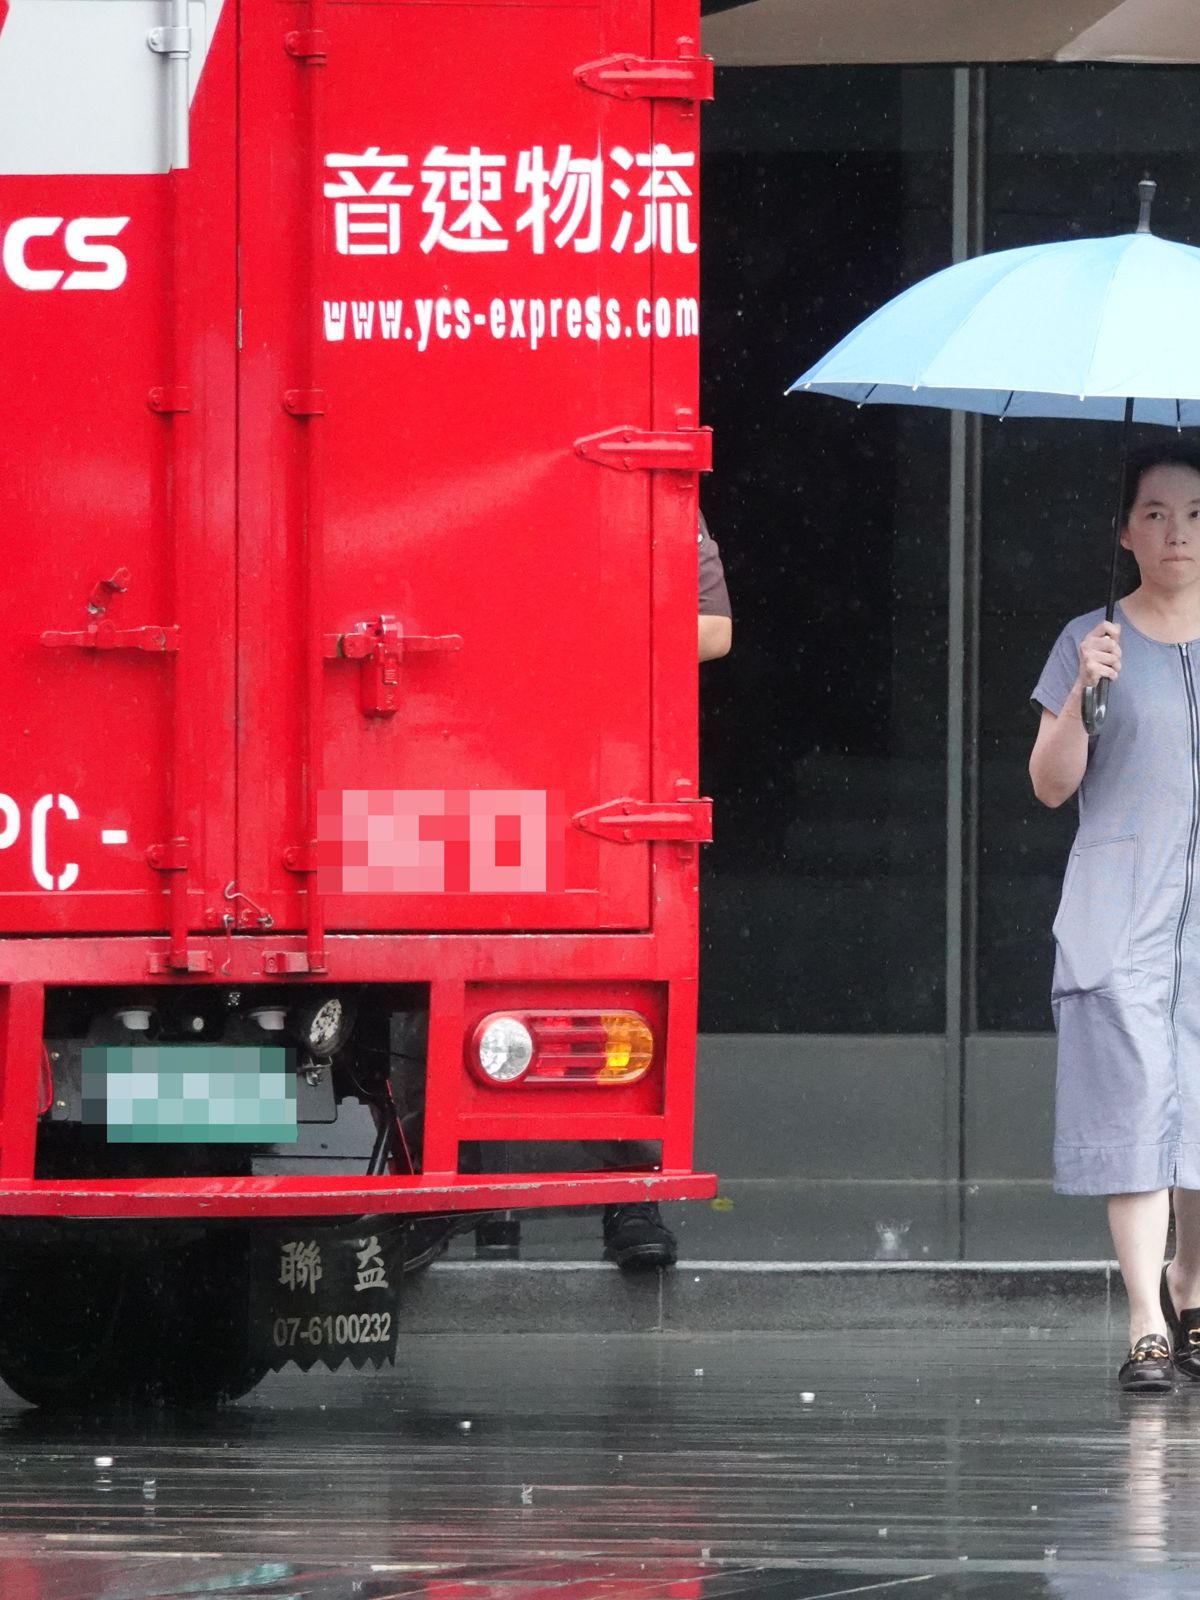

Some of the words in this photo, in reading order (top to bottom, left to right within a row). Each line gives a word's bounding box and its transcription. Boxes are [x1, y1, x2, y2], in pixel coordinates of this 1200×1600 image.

[323, 144, 698, 255] 音速物流
[2, 216, 131, 291] CS
[323, 297, 699, 352] www.ycs-express.com
[273, 1312, 391, 1347] 07-6100232
